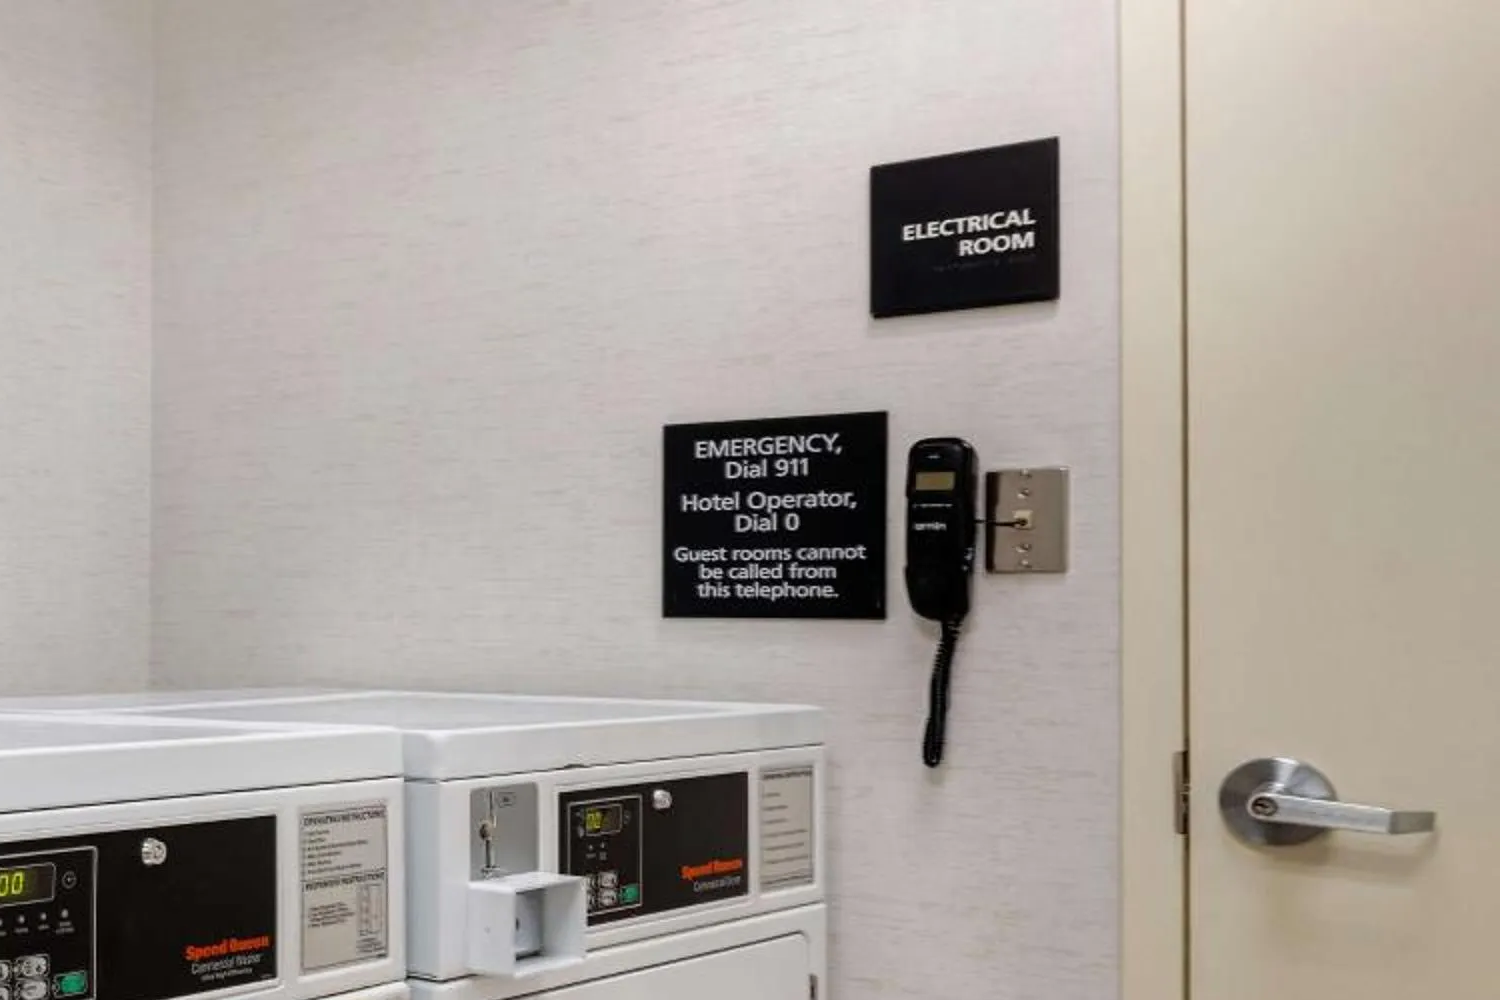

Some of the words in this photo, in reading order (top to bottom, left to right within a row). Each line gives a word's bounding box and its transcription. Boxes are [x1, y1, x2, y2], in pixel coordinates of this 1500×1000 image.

[902, 208, 1036, 241] ELECTRICAL
[959, 231, 1035, 256] ROOM
[694, 433, 842, 459] EMERGENCY,
[725, 458, 767, 479] Dial
[775, 458, 809, 477] 911
[681, 491, 740, 512] Hotel
[747, 490, 857, 513] Operator,
[735, 514, 777, 532] Dial
[785, 513, 800, 531] 0
[673, 546, 728, 562] Guest
[731, 547, 791, 561] rooms
[796, 545, 867, 560] cannot
[699, 564, 723, 579] be
[728, 563, 782, 579] called
[788, 562, 837, 579] from
[697, 582, 731, 598] this
[735, 582, 839, 601] telephone.
